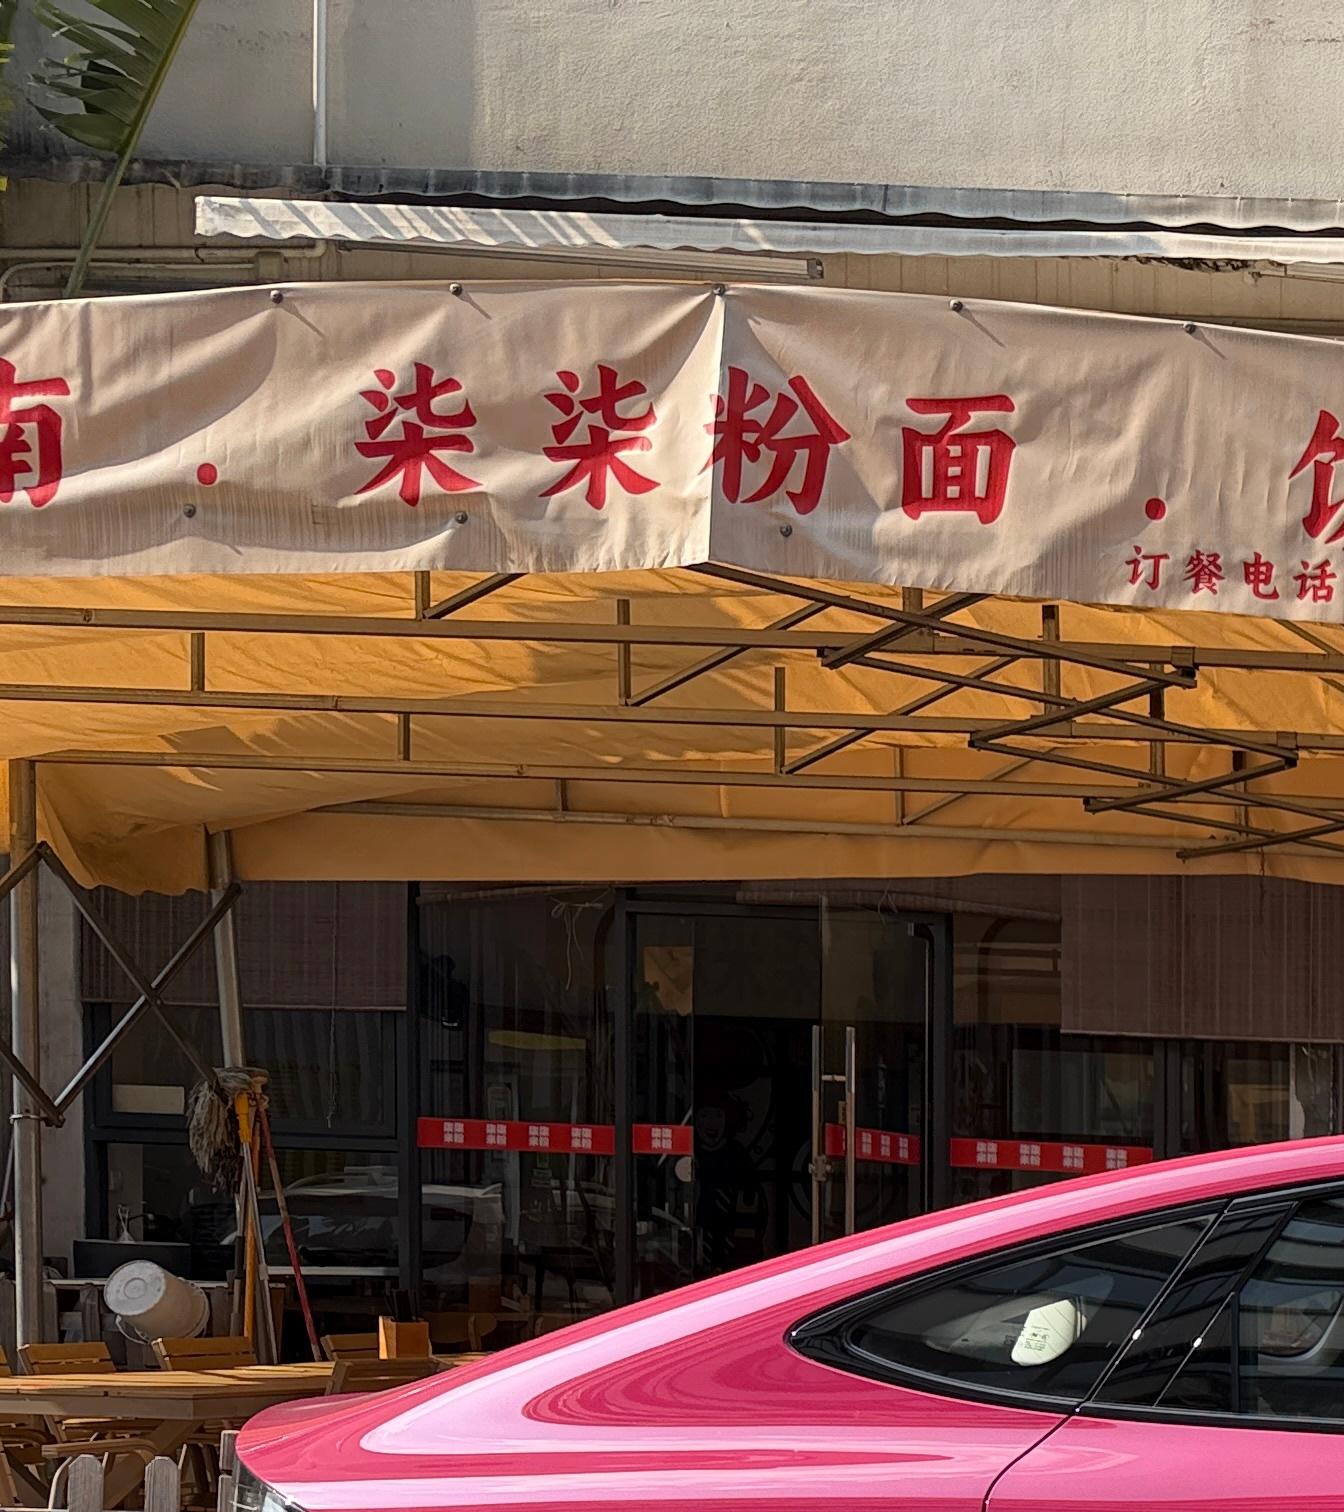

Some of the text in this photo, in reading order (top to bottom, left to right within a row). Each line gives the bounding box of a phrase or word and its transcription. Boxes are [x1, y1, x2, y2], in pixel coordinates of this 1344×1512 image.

[0, 358, 71, 507] 南
[354, 361, 1018, 525] 柒柒粉面
